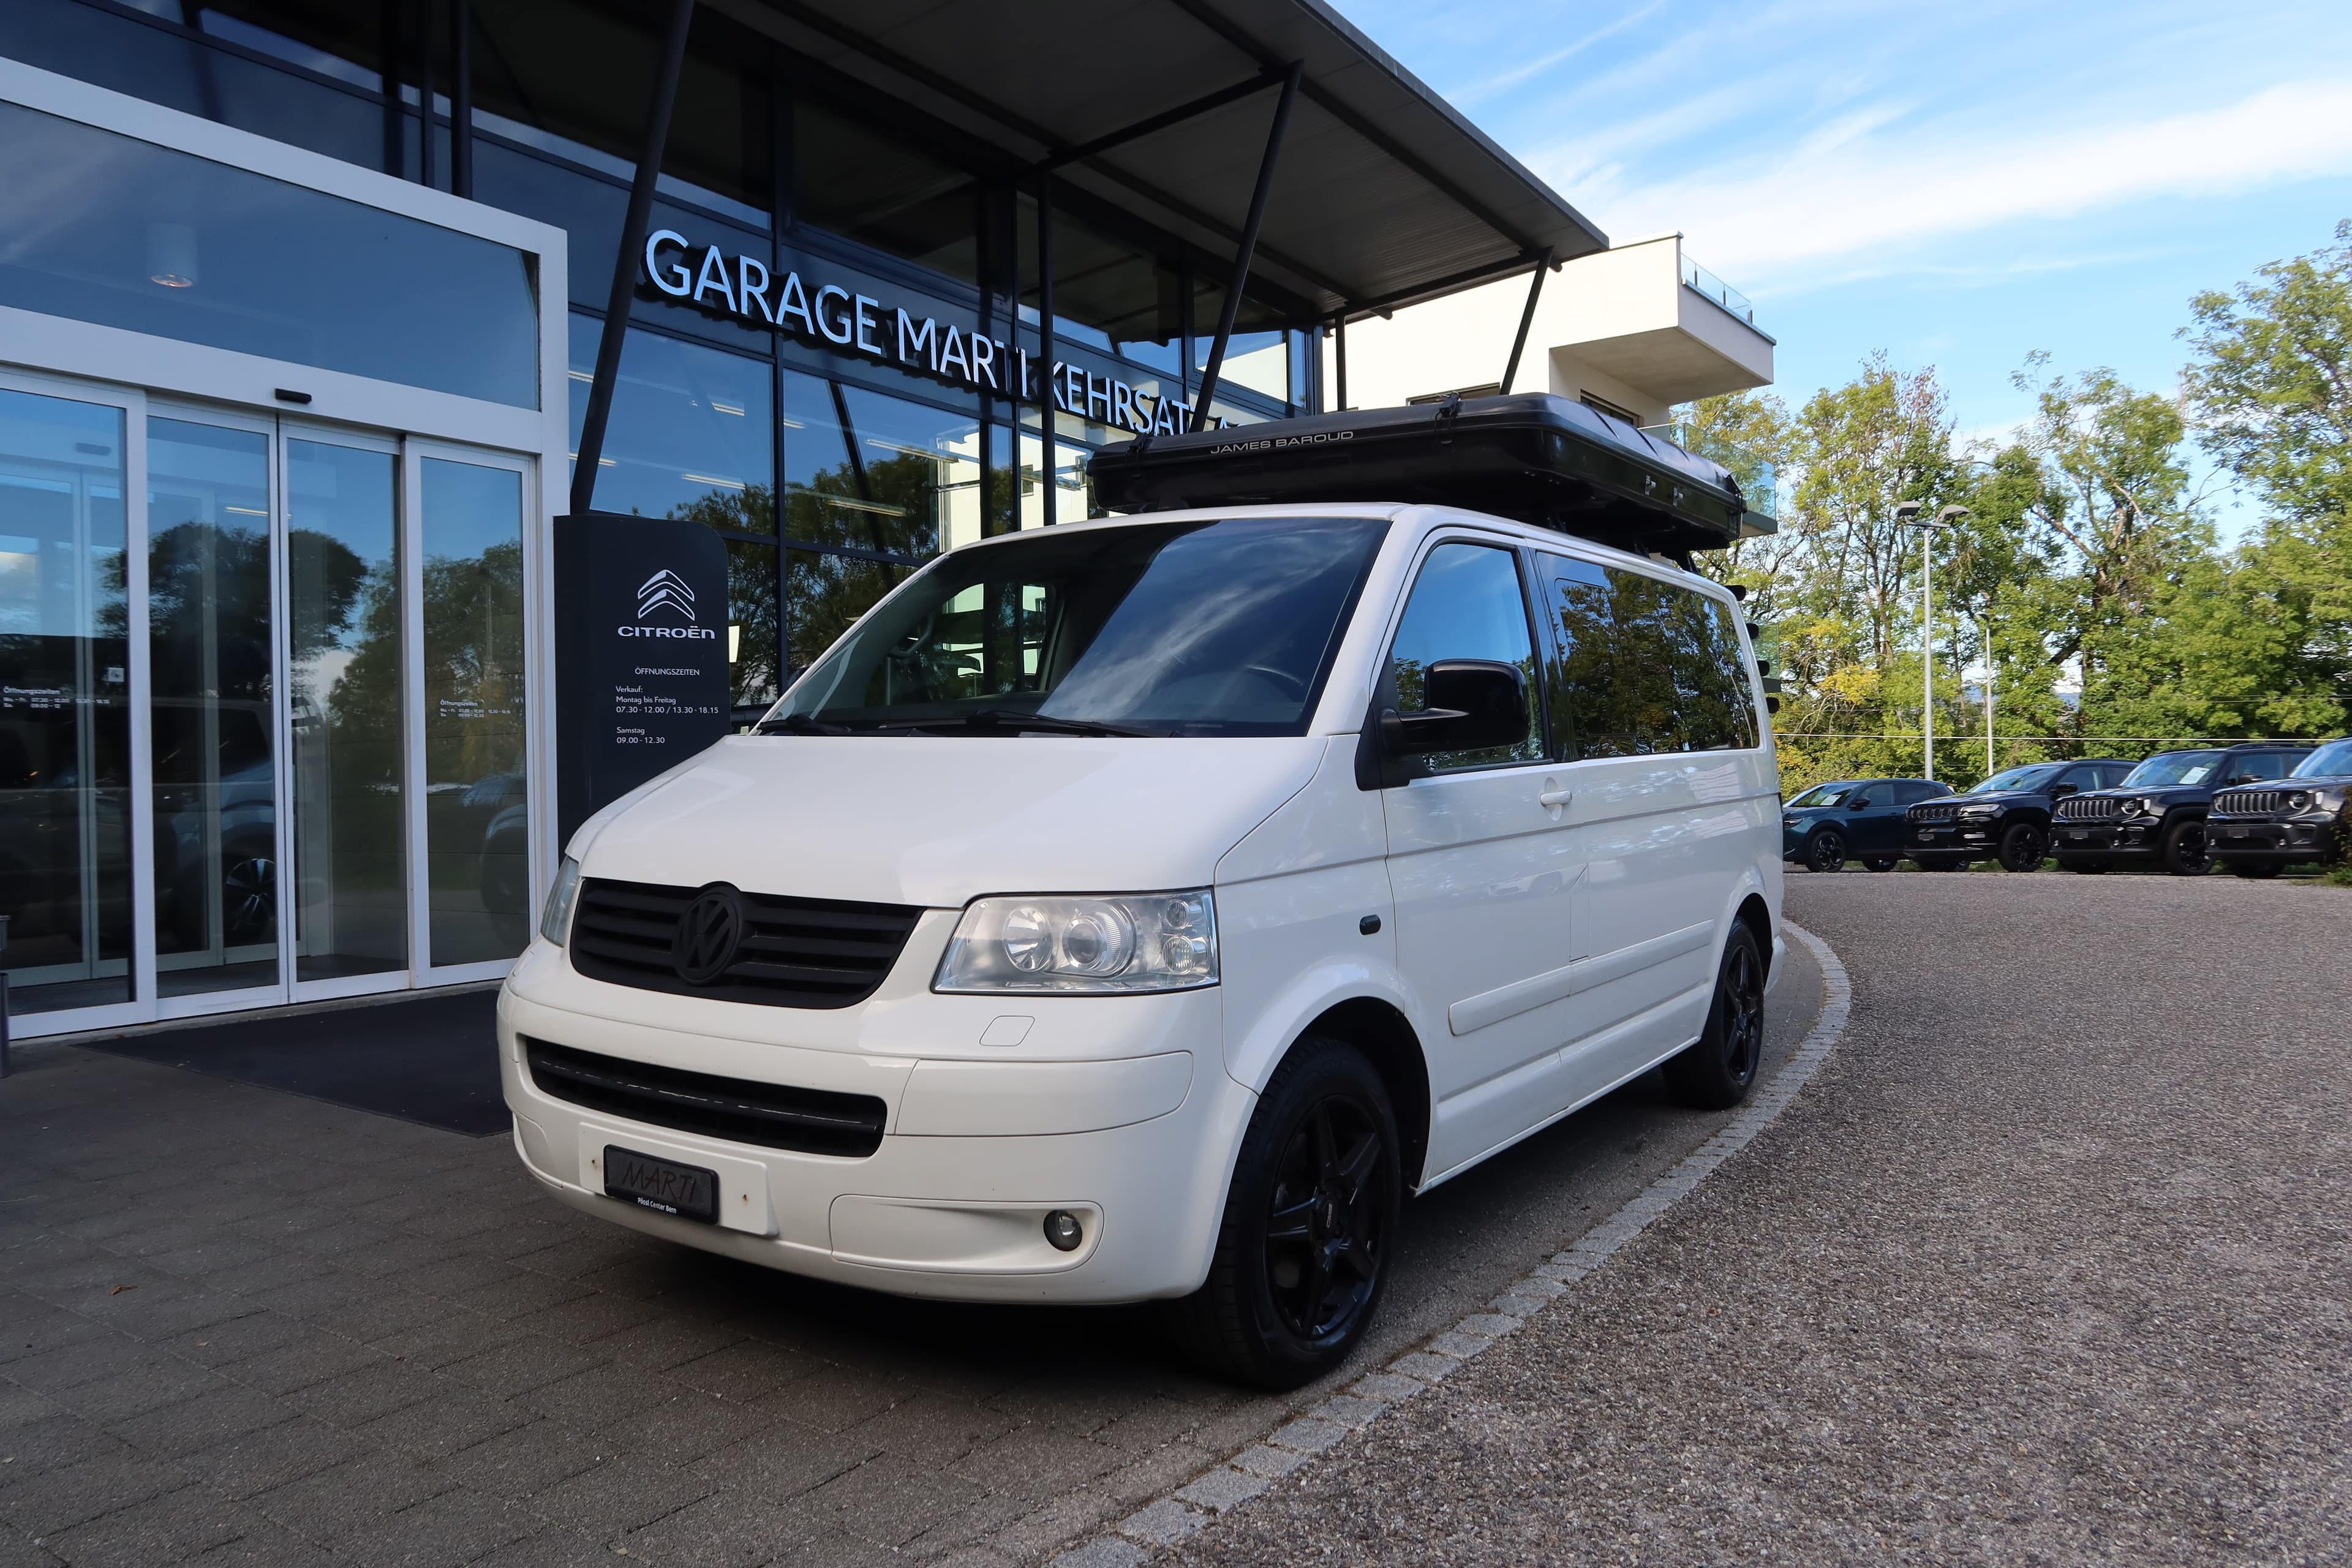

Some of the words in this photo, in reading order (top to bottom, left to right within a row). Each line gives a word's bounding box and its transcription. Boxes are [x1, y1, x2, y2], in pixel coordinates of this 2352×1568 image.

[646, 230, 881, 355] GARAGE
[897, 307, 1027, 398] MARTI
[1053, 361, 1195, 436] KEHRSAT
[1210, 440, 1270, 454] JAMES
[1276, 431, 1354, 447] BAROUD
[635, 666, 700, 676] ÖFFNUNGSZEITEN
[616, 696, 642, 705] Montag
[654, 696, 676, 705] Freitag
[616, 726, 645, 735] Samstag
[622, 1161, 696, 1203] MARTI
[650, 1200, 665, 1210] Center
[666, 1205, 677, 1213] Bern
